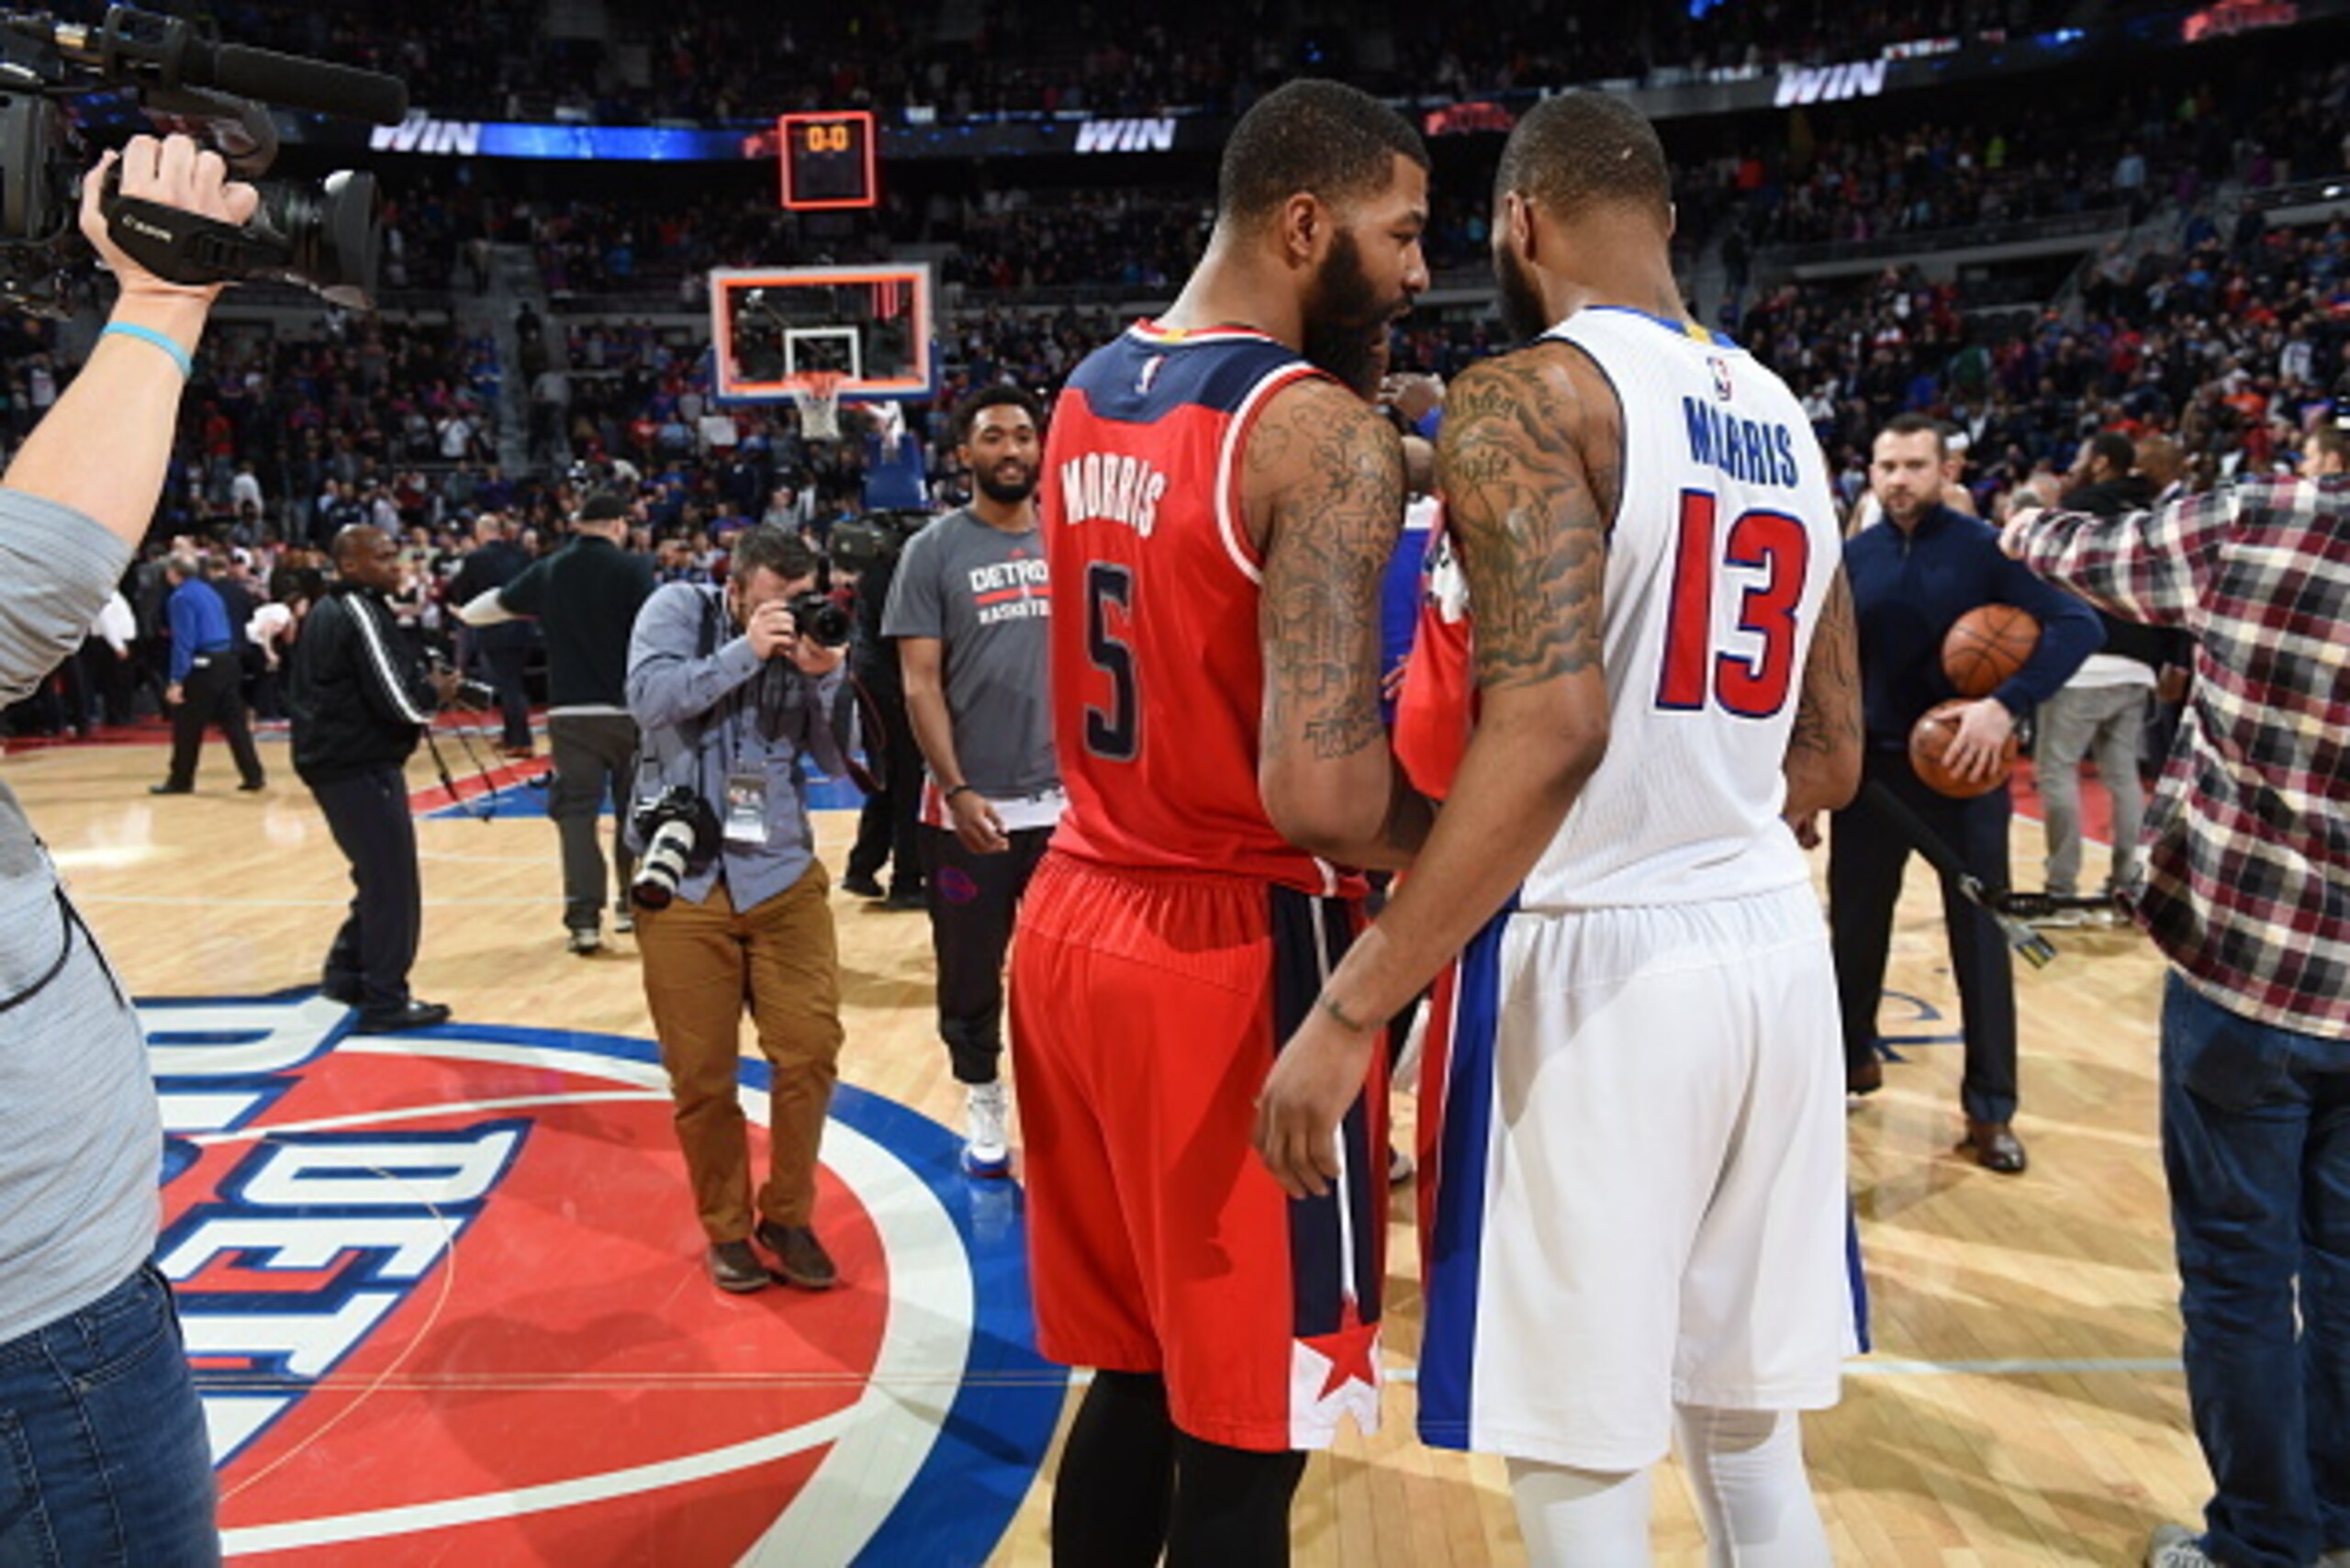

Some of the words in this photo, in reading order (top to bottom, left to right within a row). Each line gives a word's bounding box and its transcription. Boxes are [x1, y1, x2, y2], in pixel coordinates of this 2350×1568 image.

[1774, 58, 1887, 107] WIN
[369, 118, 482, 155] WIN
[1074, 118, 1176, 152] WIN
[1061, 451, 1166, 540] MORRIS
[1654, 487, 1811, 719] 13
[1084, 559, 1139, 762] 5
